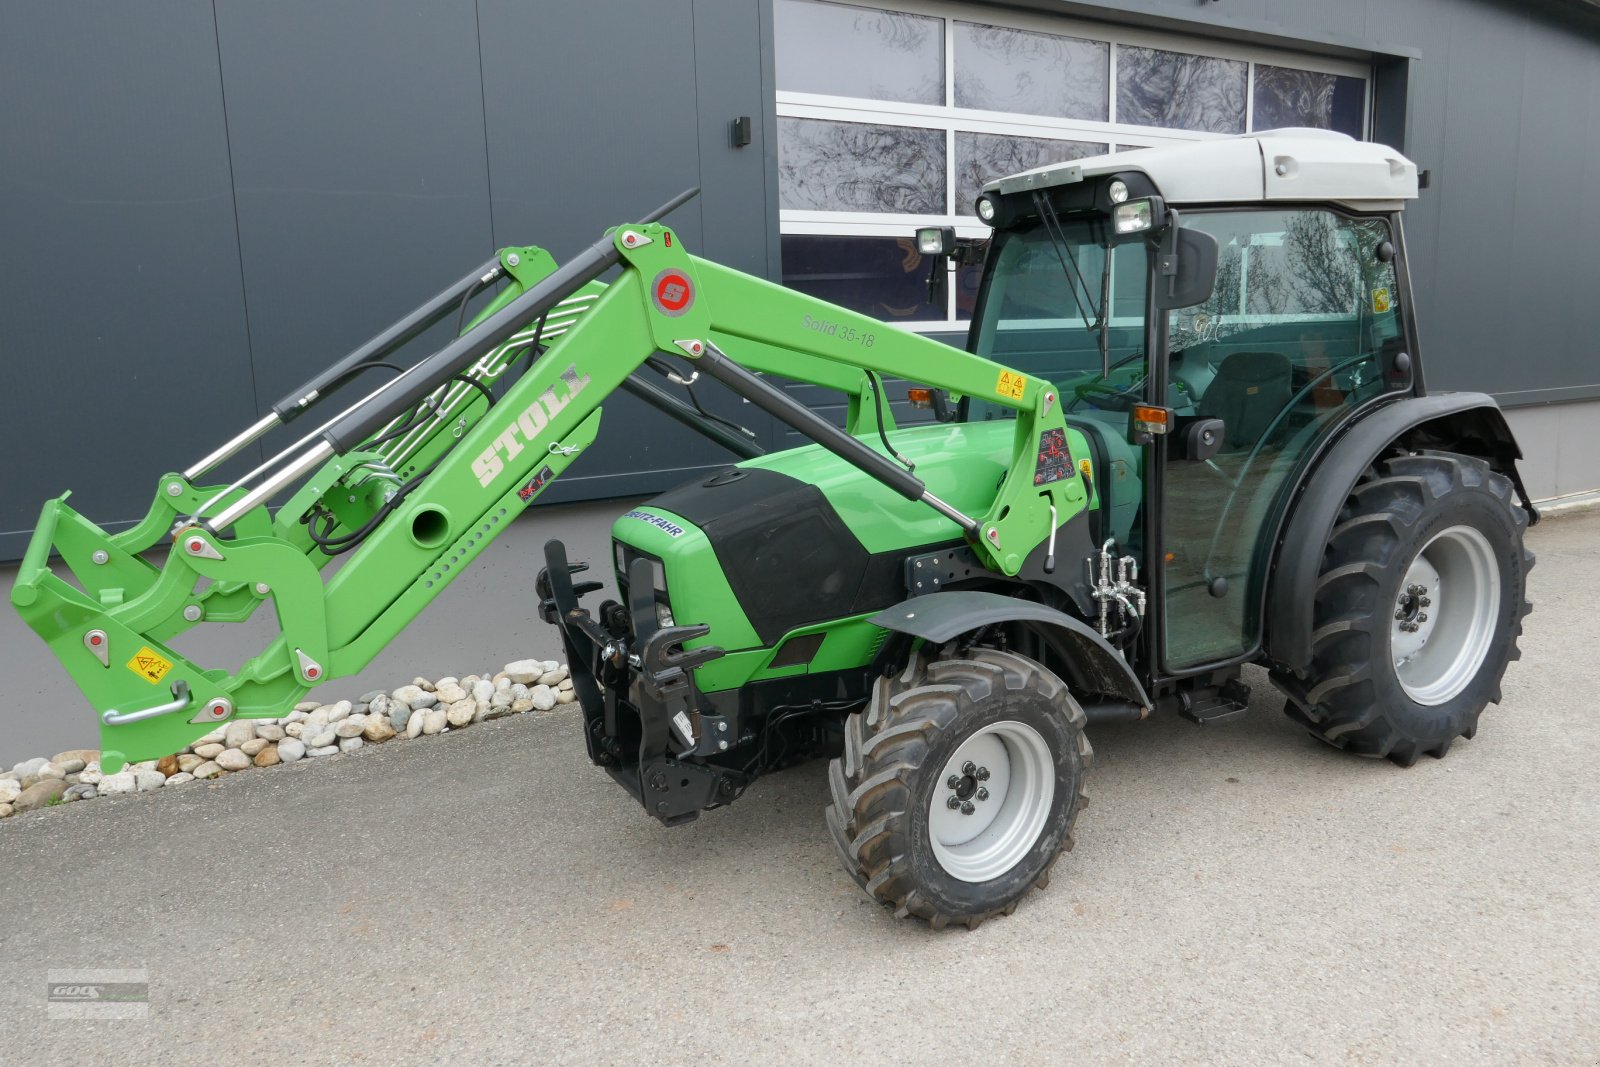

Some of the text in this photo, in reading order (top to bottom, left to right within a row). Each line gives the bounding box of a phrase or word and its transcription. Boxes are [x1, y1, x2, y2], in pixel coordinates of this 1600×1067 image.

[802, 313, 875, 348] Solid 35-18
[470, 362, 591, 489] STOLL
